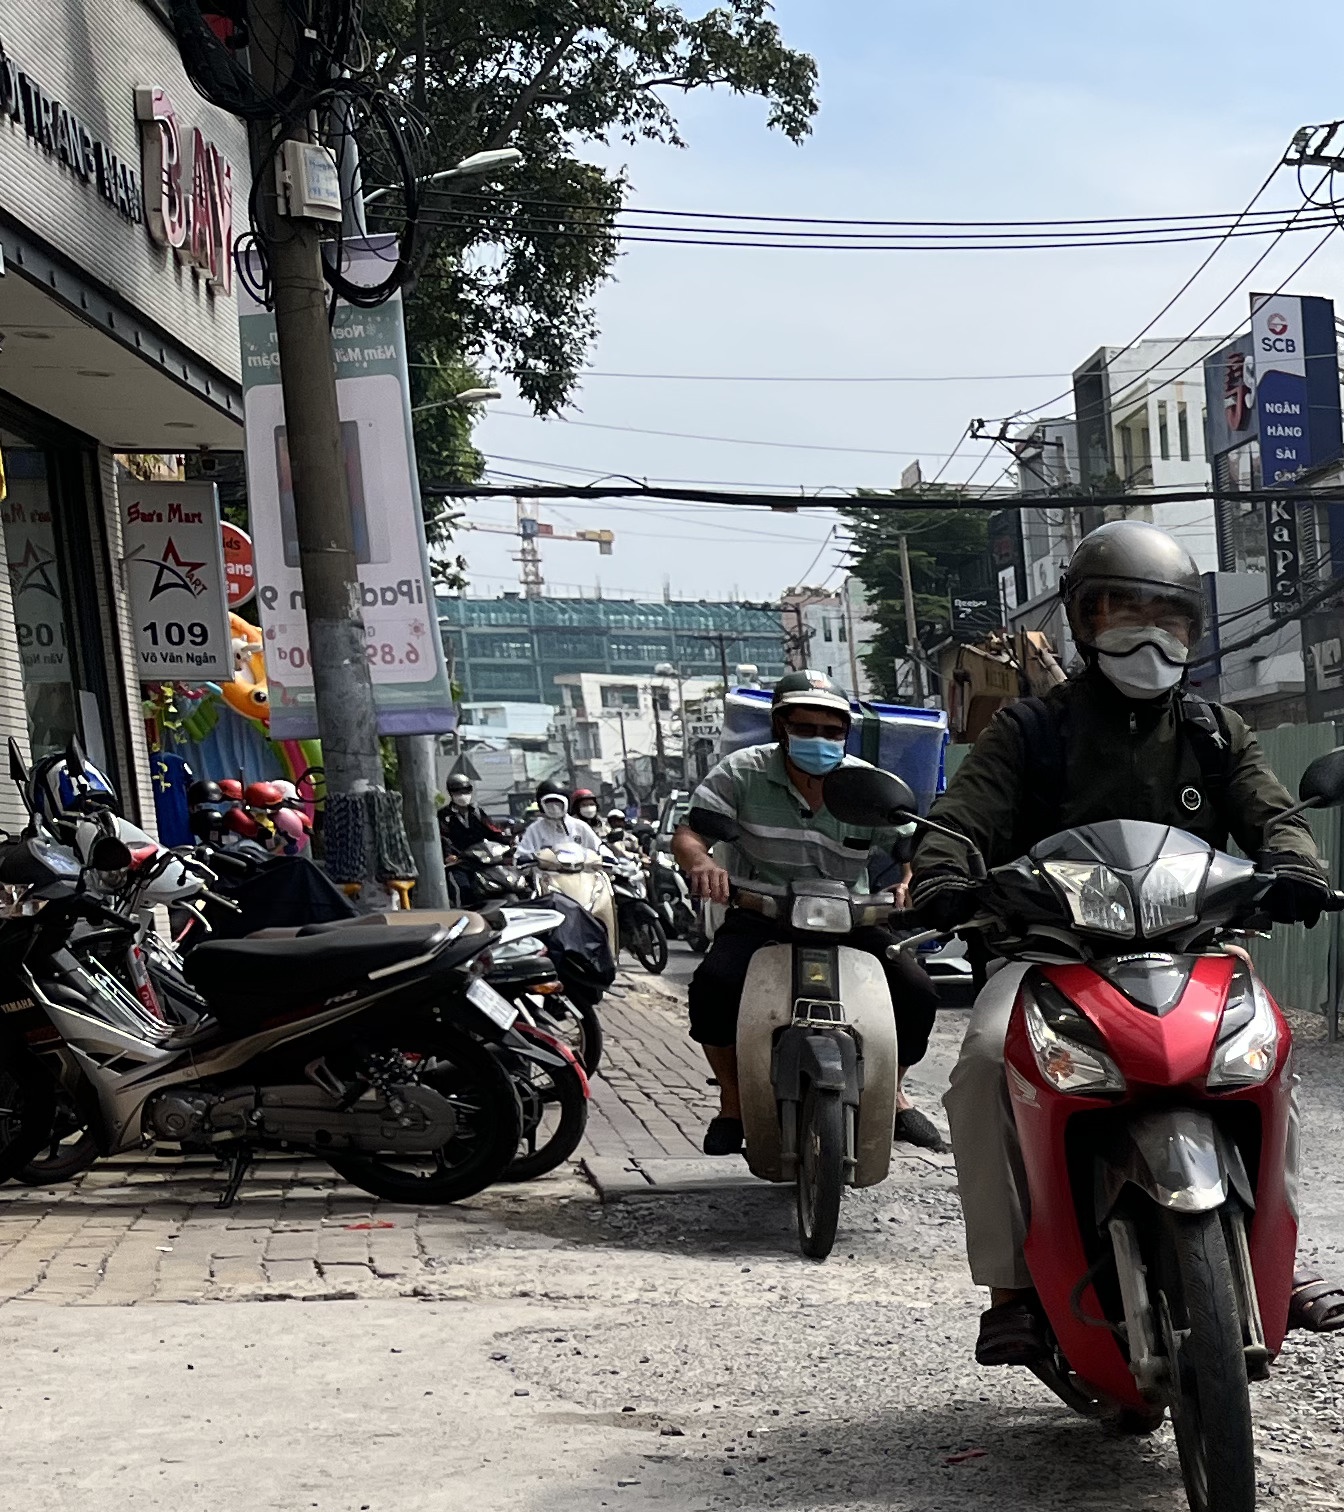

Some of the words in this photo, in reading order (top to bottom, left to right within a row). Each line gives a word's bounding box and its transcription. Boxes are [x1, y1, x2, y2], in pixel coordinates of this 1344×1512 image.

[1261, 337, 1296, 353] SCB
[1266, 402, 1300, 415] NGÂN
[1267, 424, 1303, 437] HÀNG
[1275, 446, 1296, 459] SÀI
[142, 621, 209, 647] 109
[141, 650, 158, 664] Võ
[161, 650, 183, 664] Văn
[186, 651, 217, 666] Ngân
